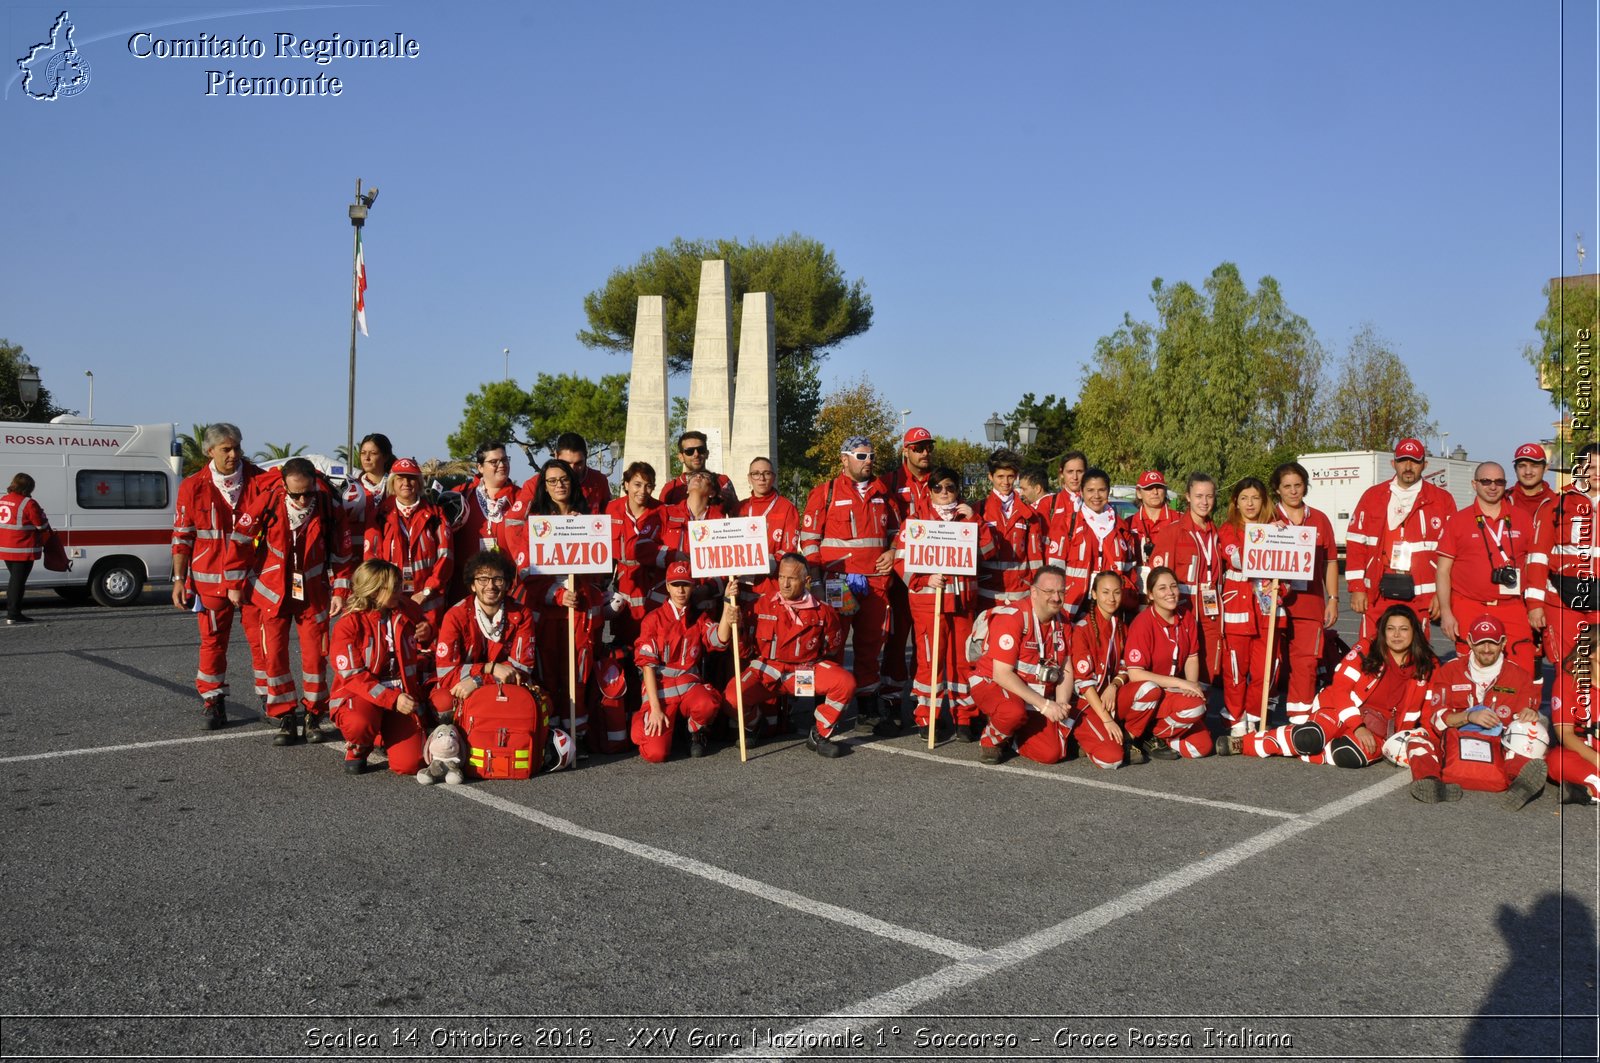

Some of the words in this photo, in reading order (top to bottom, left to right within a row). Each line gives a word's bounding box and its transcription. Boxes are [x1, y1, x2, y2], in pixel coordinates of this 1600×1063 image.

[5, 435, 55, 445] ROSSA
[59, 437, 120, 447] ITALIANA
[1313, 469, 1359, 478] MUSIC
[535, 542, 608, 566] LAZIO
[694, 543, 766, 570] UMBRIA
[909, 544, 973, 568] LIGURIA
[1247, 549, 1299, 573] SICILIA
[1303, 551, 1312, 573] 2
